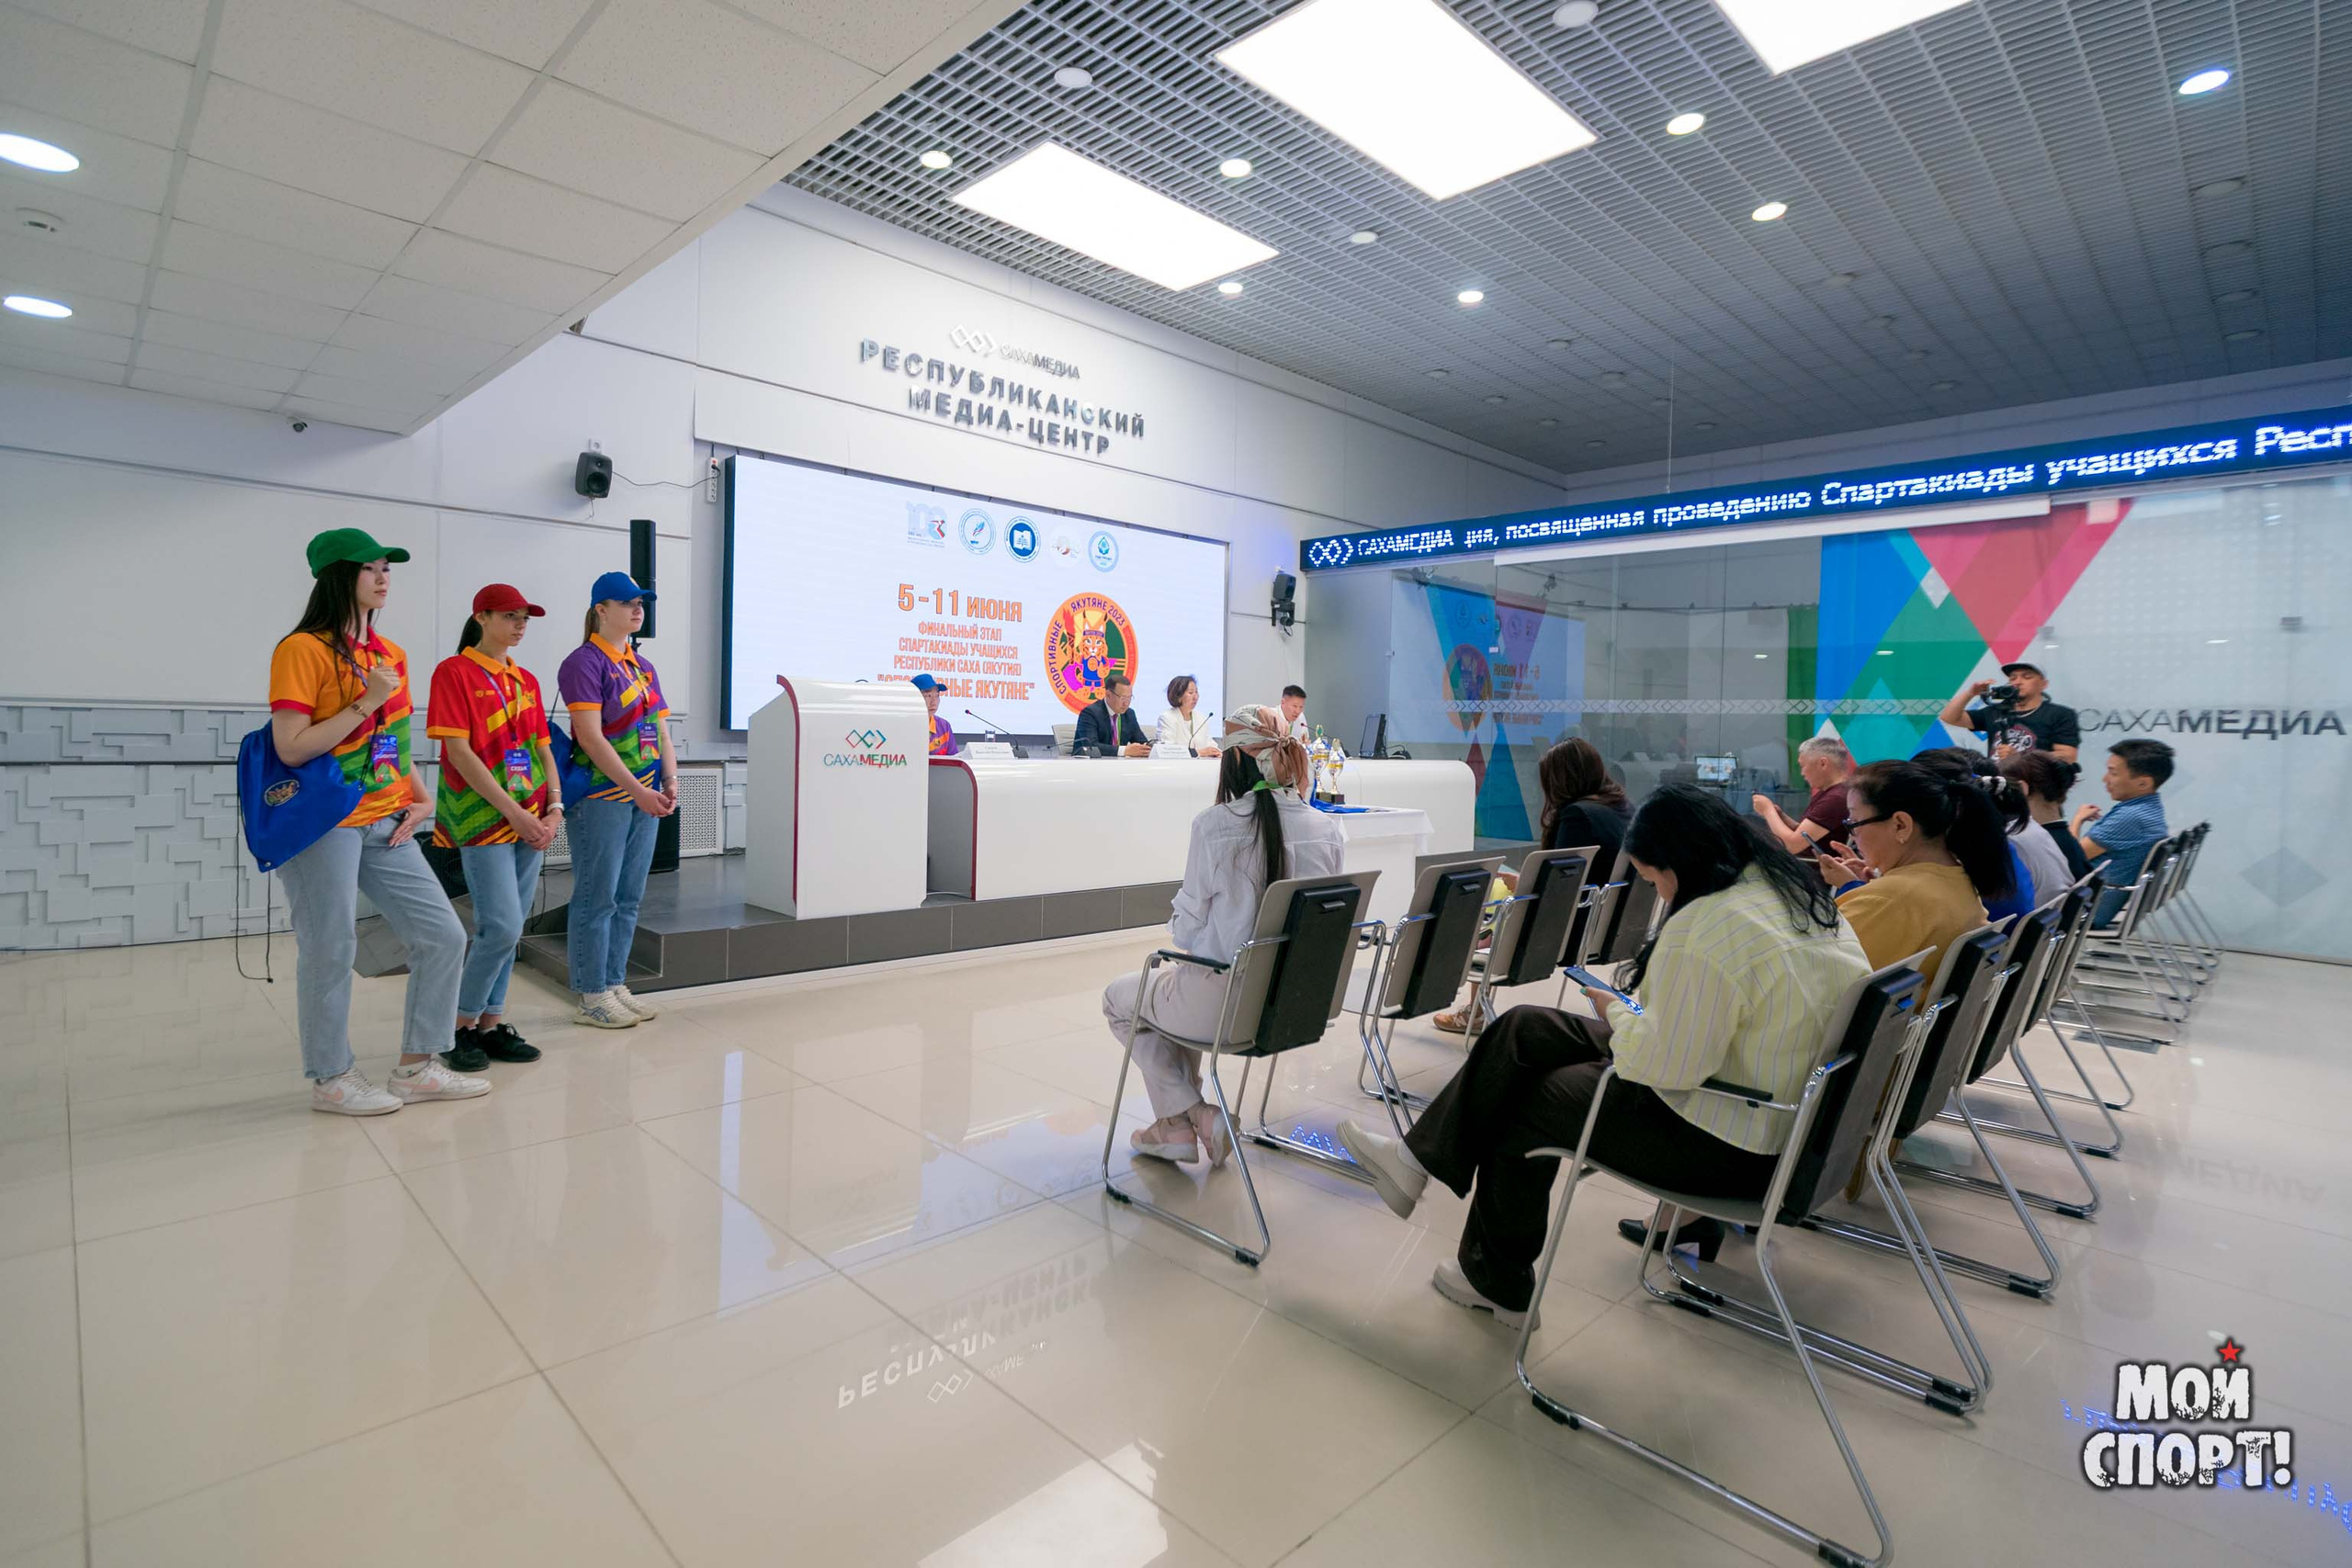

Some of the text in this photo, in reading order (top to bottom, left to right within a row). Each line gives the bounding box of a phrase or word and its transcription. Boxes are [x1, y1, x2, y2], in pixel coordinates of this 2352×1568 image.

[1000, 342, 1080, 380] САХАМЕДИА
[859, 337, 1145, 438] РЕСПУБЛИКАНСКИЙ
[908, 384, 1110, 456] МЕДИА-ЦЕНТР
[1506, 510, 1645, 537] посвященная
[1653, 491, 1813, 528] проведению
[1821, 463, 2035, 506] Спартакиады
[2045, 438, 2239, 486] учащихся
[967, 595, 1023, 623] ИЮНЯ
[918, 620, 1002, 642] ФИНАЛЬНЫЙ ЭТАП
[1047, 597, 1125, 695] СПОРТИВНЫЕ ЯКУТЯНЕ 2023
[899, 637, 1018, 660] СПАРТАКИАДЫ УЧАЩИХСЯ
[894, 654, 1022, 676] РЕСПУБЛИКИ САХА (ЯКУТИЯ)
[975, 678, 1035, 701] ЯКУТЯНЕ"
[2077, 707, 2347, 740] САХАМЕДИА
[823, 753, 908, 769] САХАМЕДИА
